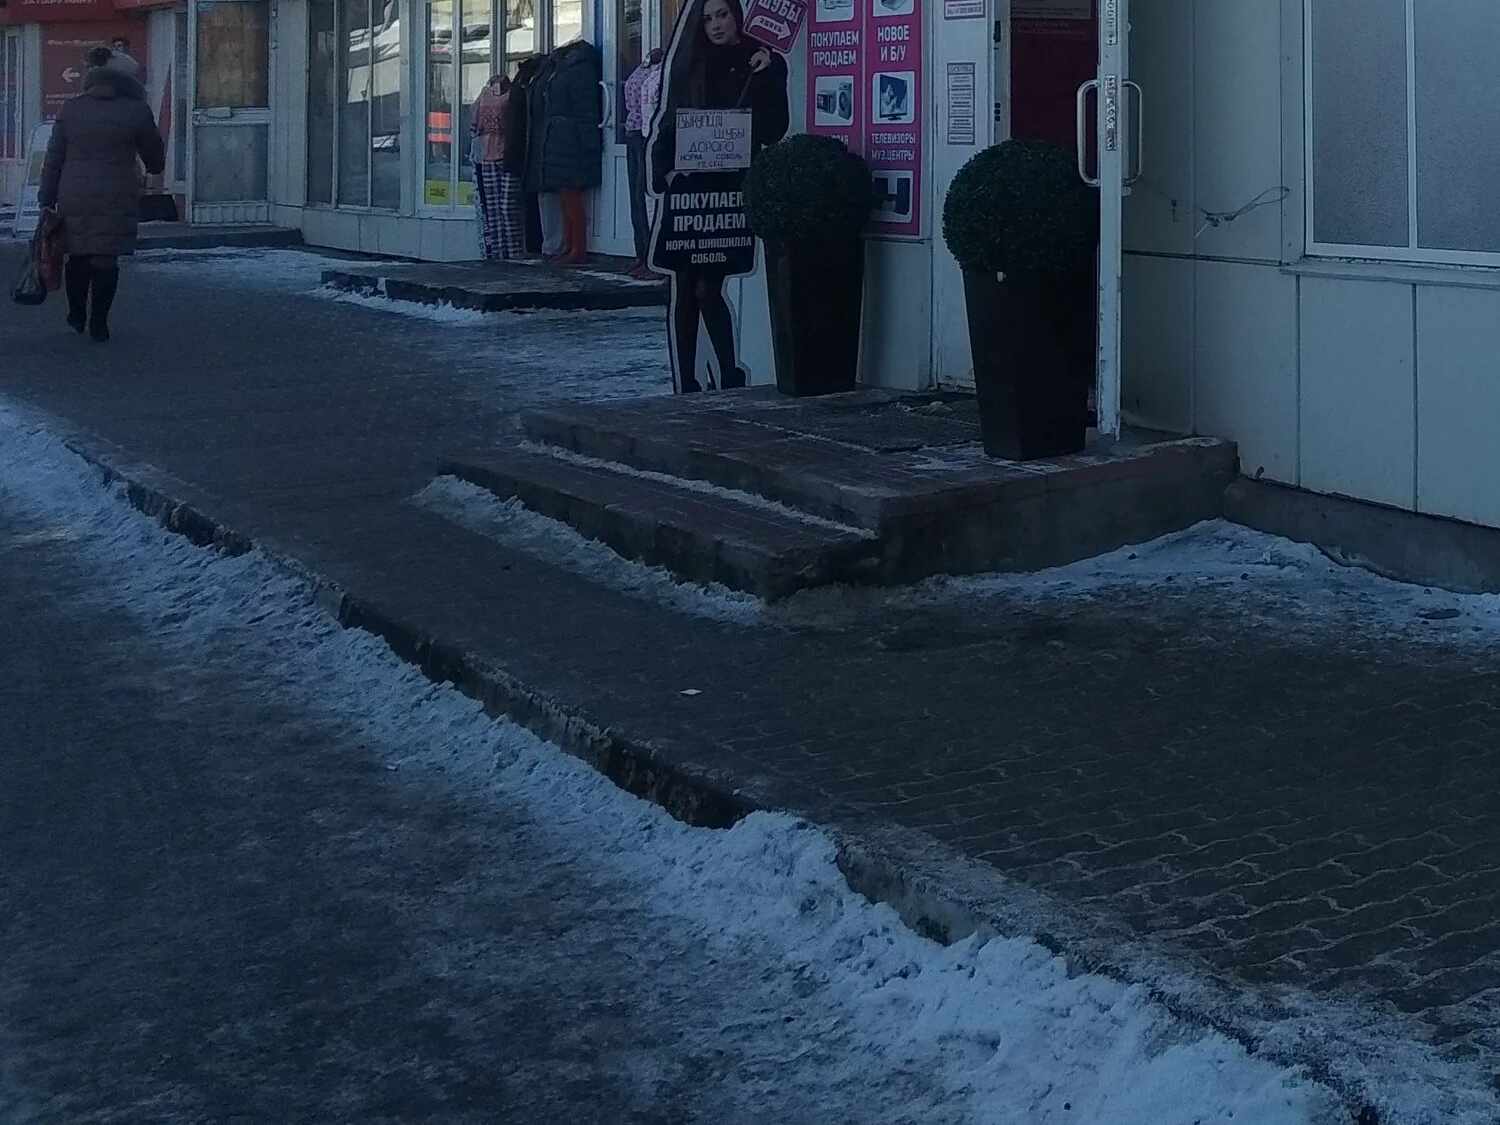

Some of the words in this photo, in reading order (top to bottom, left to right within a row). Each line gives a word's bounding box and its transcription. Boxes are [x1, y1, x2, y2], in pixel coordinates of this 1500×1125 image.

[810, 31, 860, 48] ПОКУПАЕМ
[877, 25, 910, 42] НОВОЕ
[813, 50, 857, 68] ПРОДАЕМ
[880, 48, 888, 62] И
[890, 46, 907, 62] Б/У
[688, 140, 735, 152] ДОРОГО
[871, 132, 916, 145] ТЕЛЕВИЗОРЫ
[674, 213, 746, 232] ПРОДАЕМ
[665, 239, 696, 251] НОРКА
[691, 252, 727, 264] СОБОЛЬ
